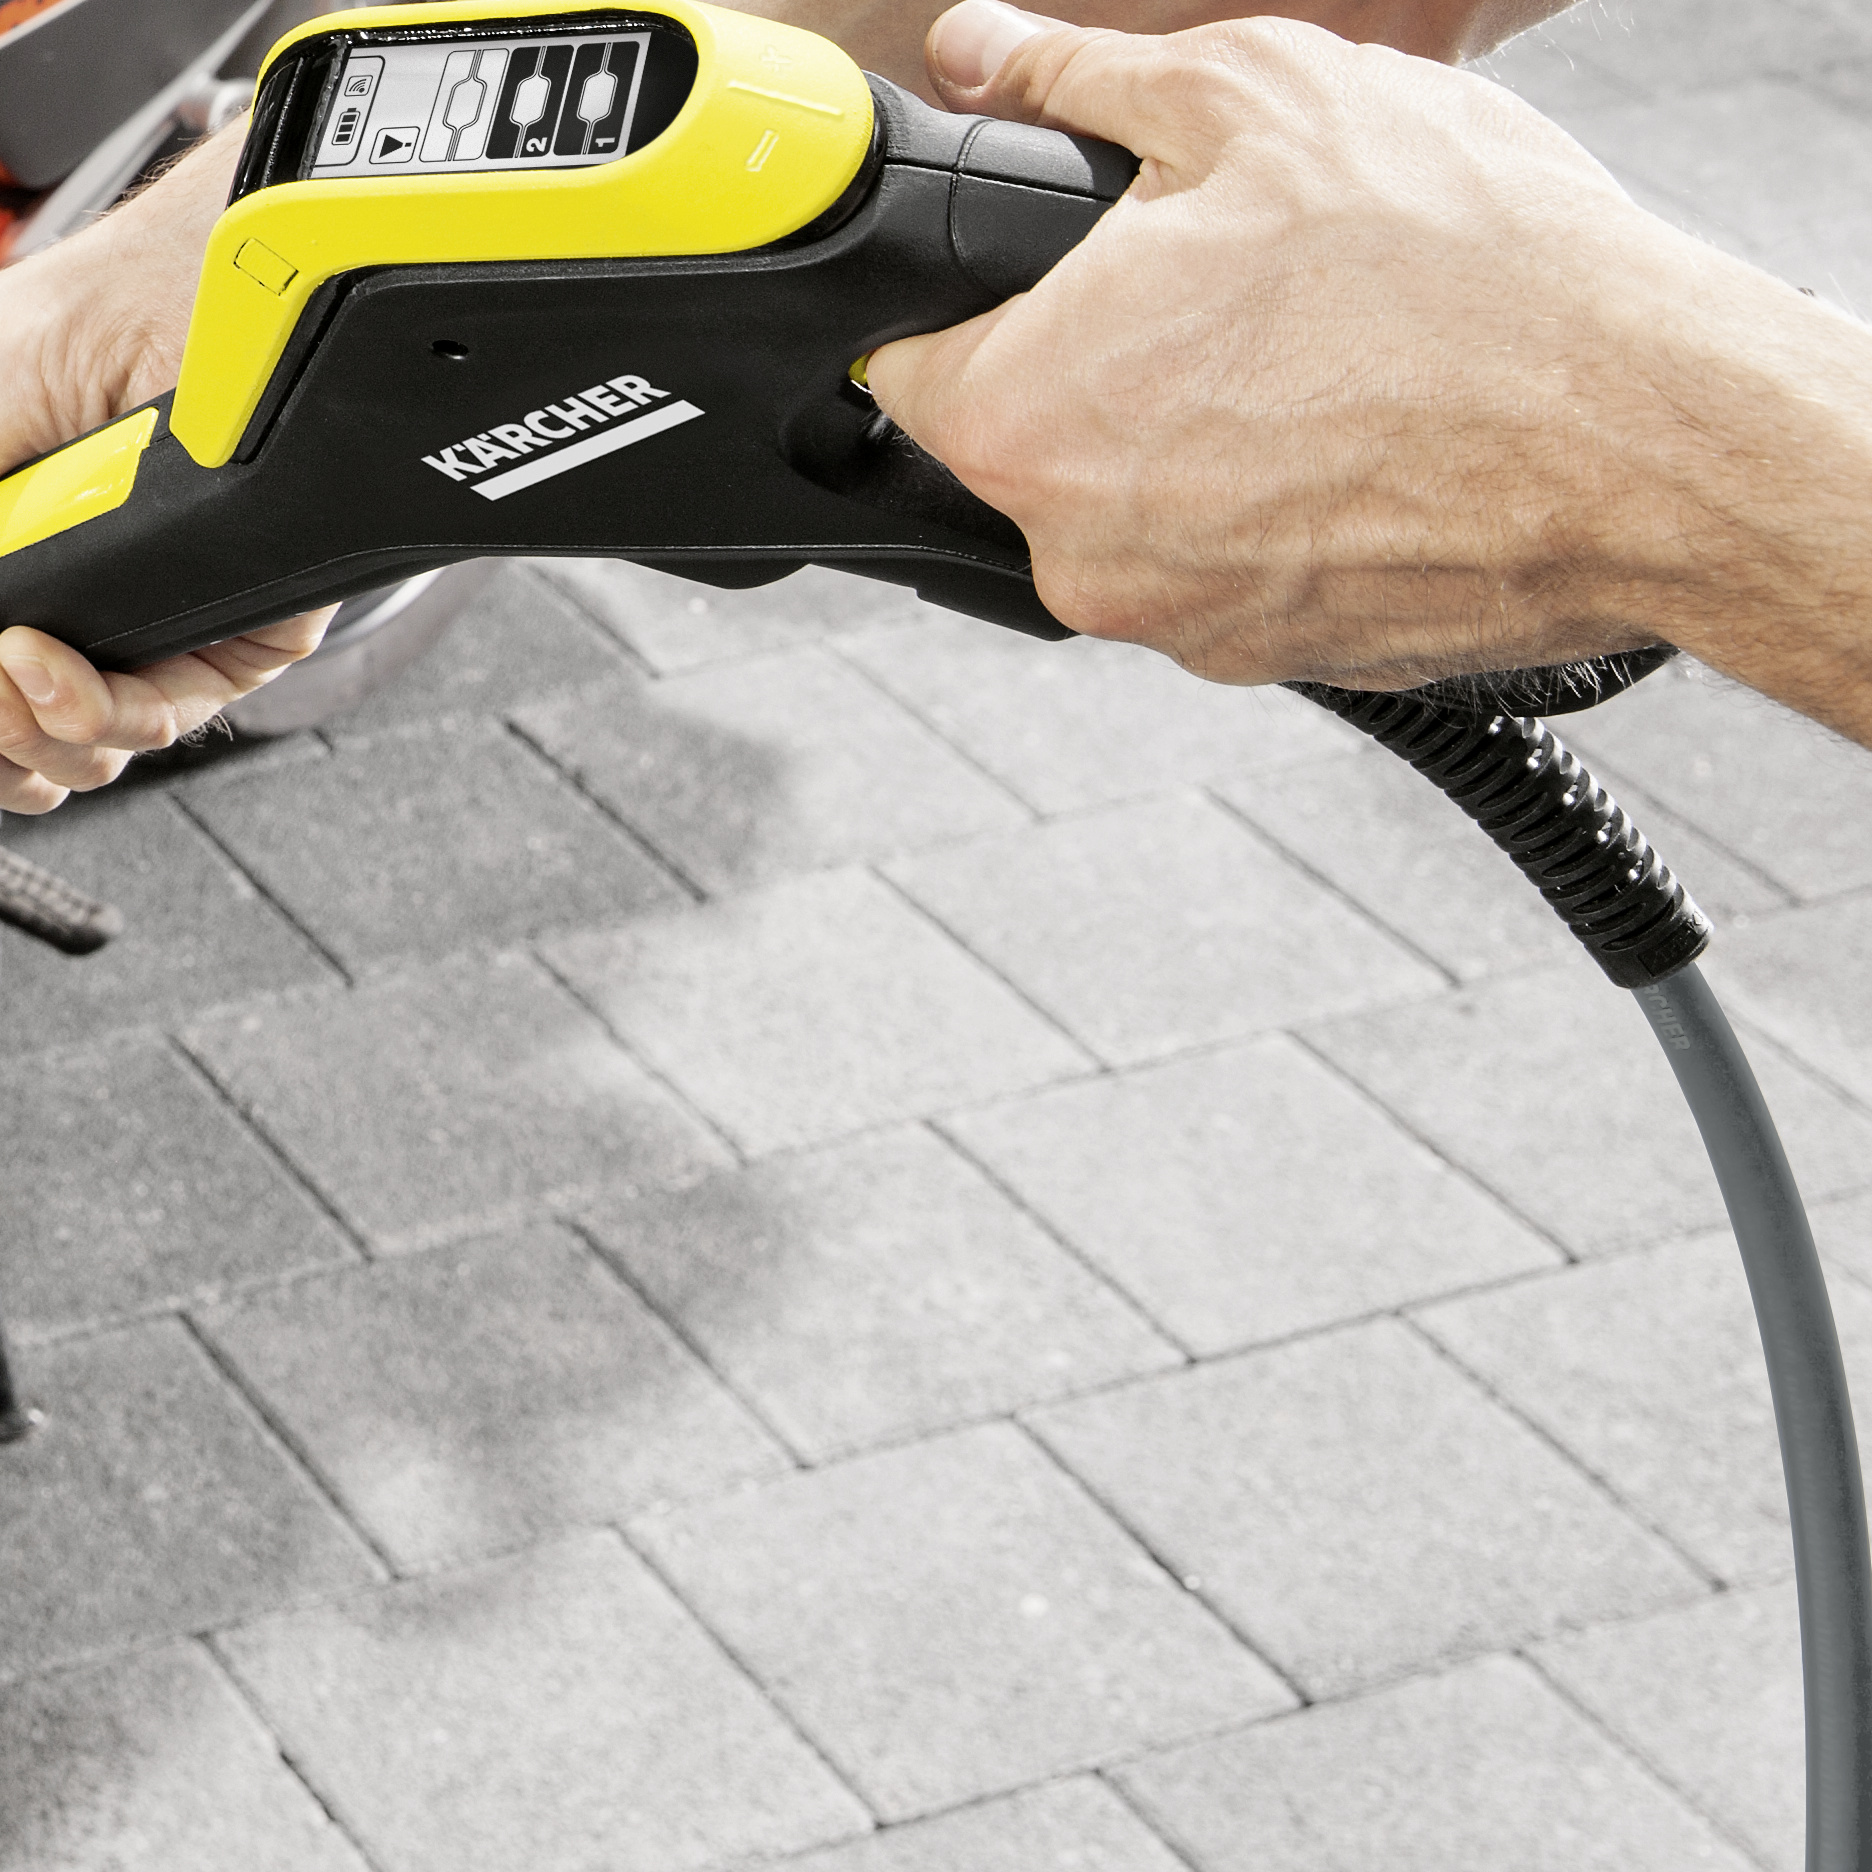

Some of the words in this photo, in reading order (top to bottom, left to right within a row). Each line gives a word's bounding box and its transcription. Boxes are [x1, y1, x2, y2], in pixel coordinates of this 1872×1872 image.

[525, 136, 548, 153] 2
[594, 136, 616, 148] 1
[420, 374, 673, 483] KÄRCHER
